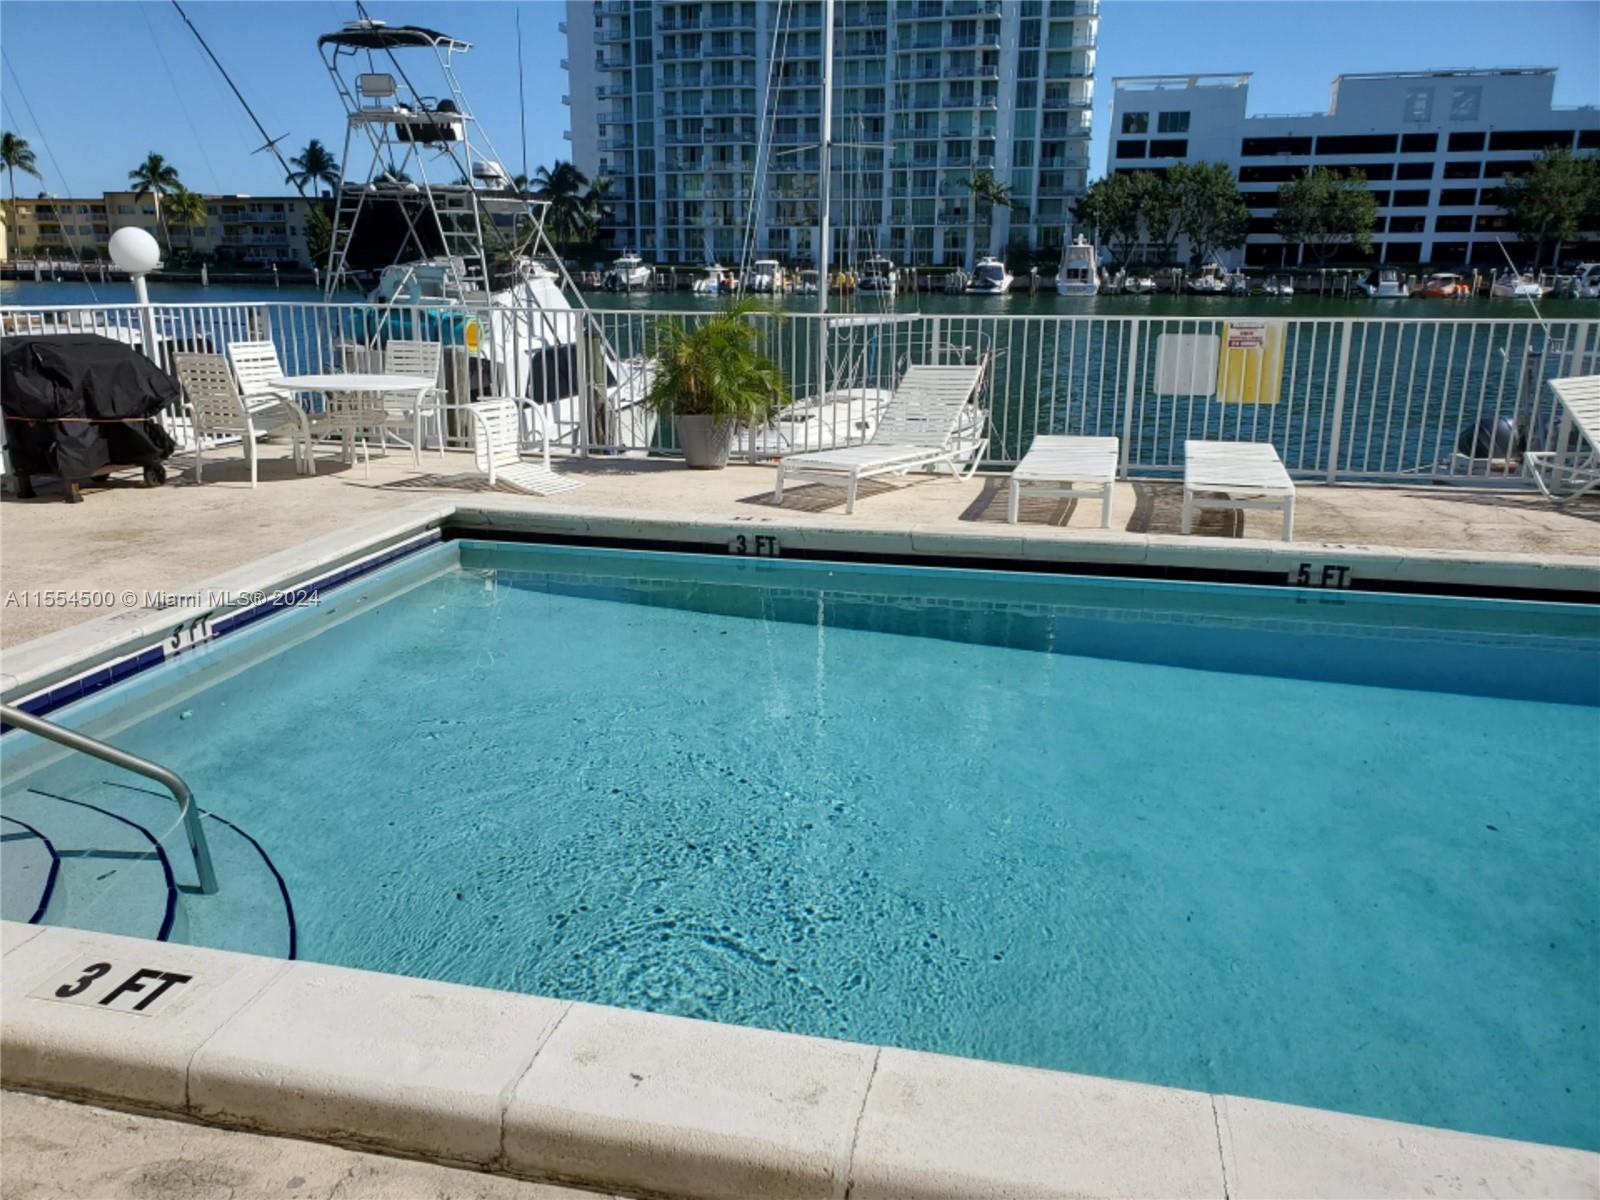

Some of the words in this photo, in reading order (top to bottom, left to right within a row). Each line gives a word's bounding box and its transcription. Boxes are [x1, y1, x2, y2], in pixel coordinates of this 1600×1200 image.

[736, 534, 747, 553] 3
[754, 534, 777, 556] FT
[1296, 563, 1312, 587] 5
[1321, 565, 1351, 588] FT
[170, 623, 184, 649] 3
[190, 611, 214, 642] FT
[55, 962, 112, 998] 3
[98, 968, 193, 1011] FT
